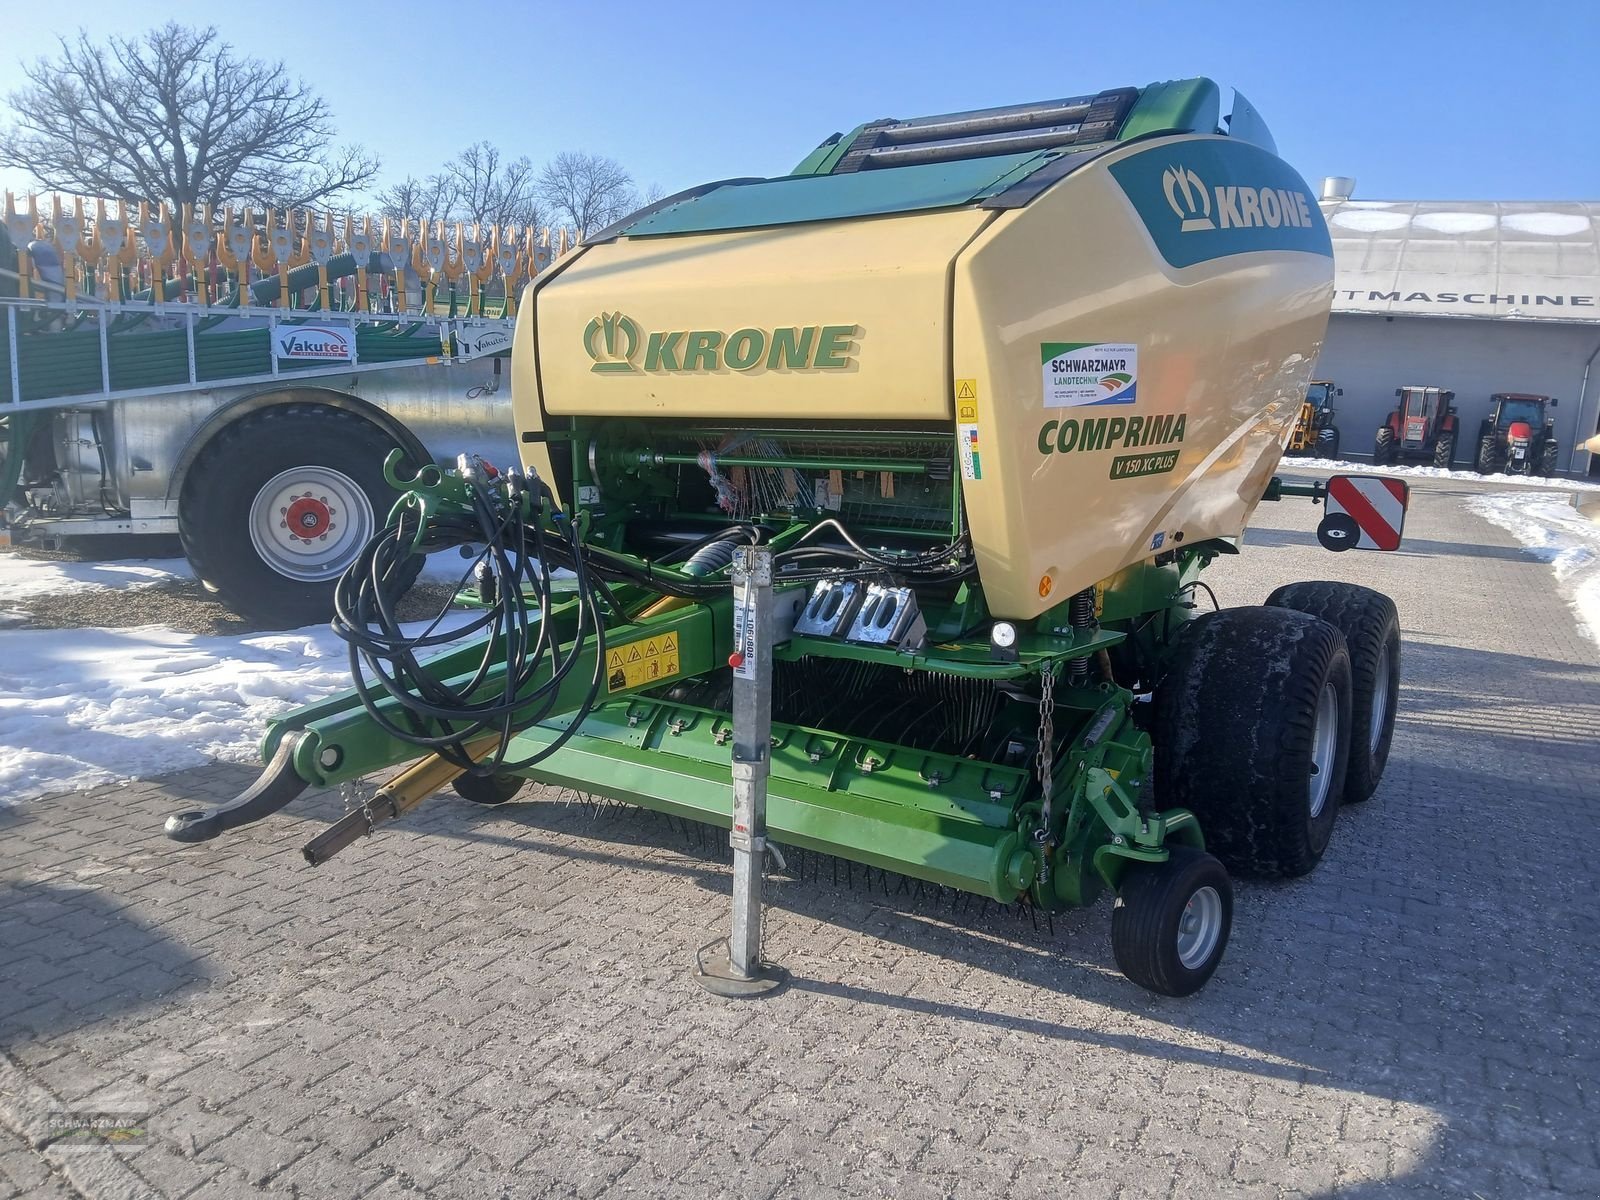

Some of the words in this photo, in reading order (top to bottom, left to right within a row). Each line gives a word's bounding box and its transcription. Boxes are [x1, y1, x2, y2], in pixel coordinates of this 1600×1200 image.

[1214, 186, 1312, 229] KRONE
[1332, 290, 1600, 306] TMASCHINE
[280, 336, 348, 355] Vakutec
[474, 336, 508, 352] Vakutec
[644, 325, 858, 371] KRONE
[1052, 360, 1126, 373] SCHWARZMAYR
[1054, 376, 1099, 386] LANDTECHNIK
[1038, 414, 1187, 455] COMPRIMA
[1116, 461, 1124, 475] V
[1125, 459, 1141, 473] 150
[1141, 457, 1155, 471] XC
[1154, 455, 1175, 469] PLUS
[746, 619, 755, 658] 1060808
